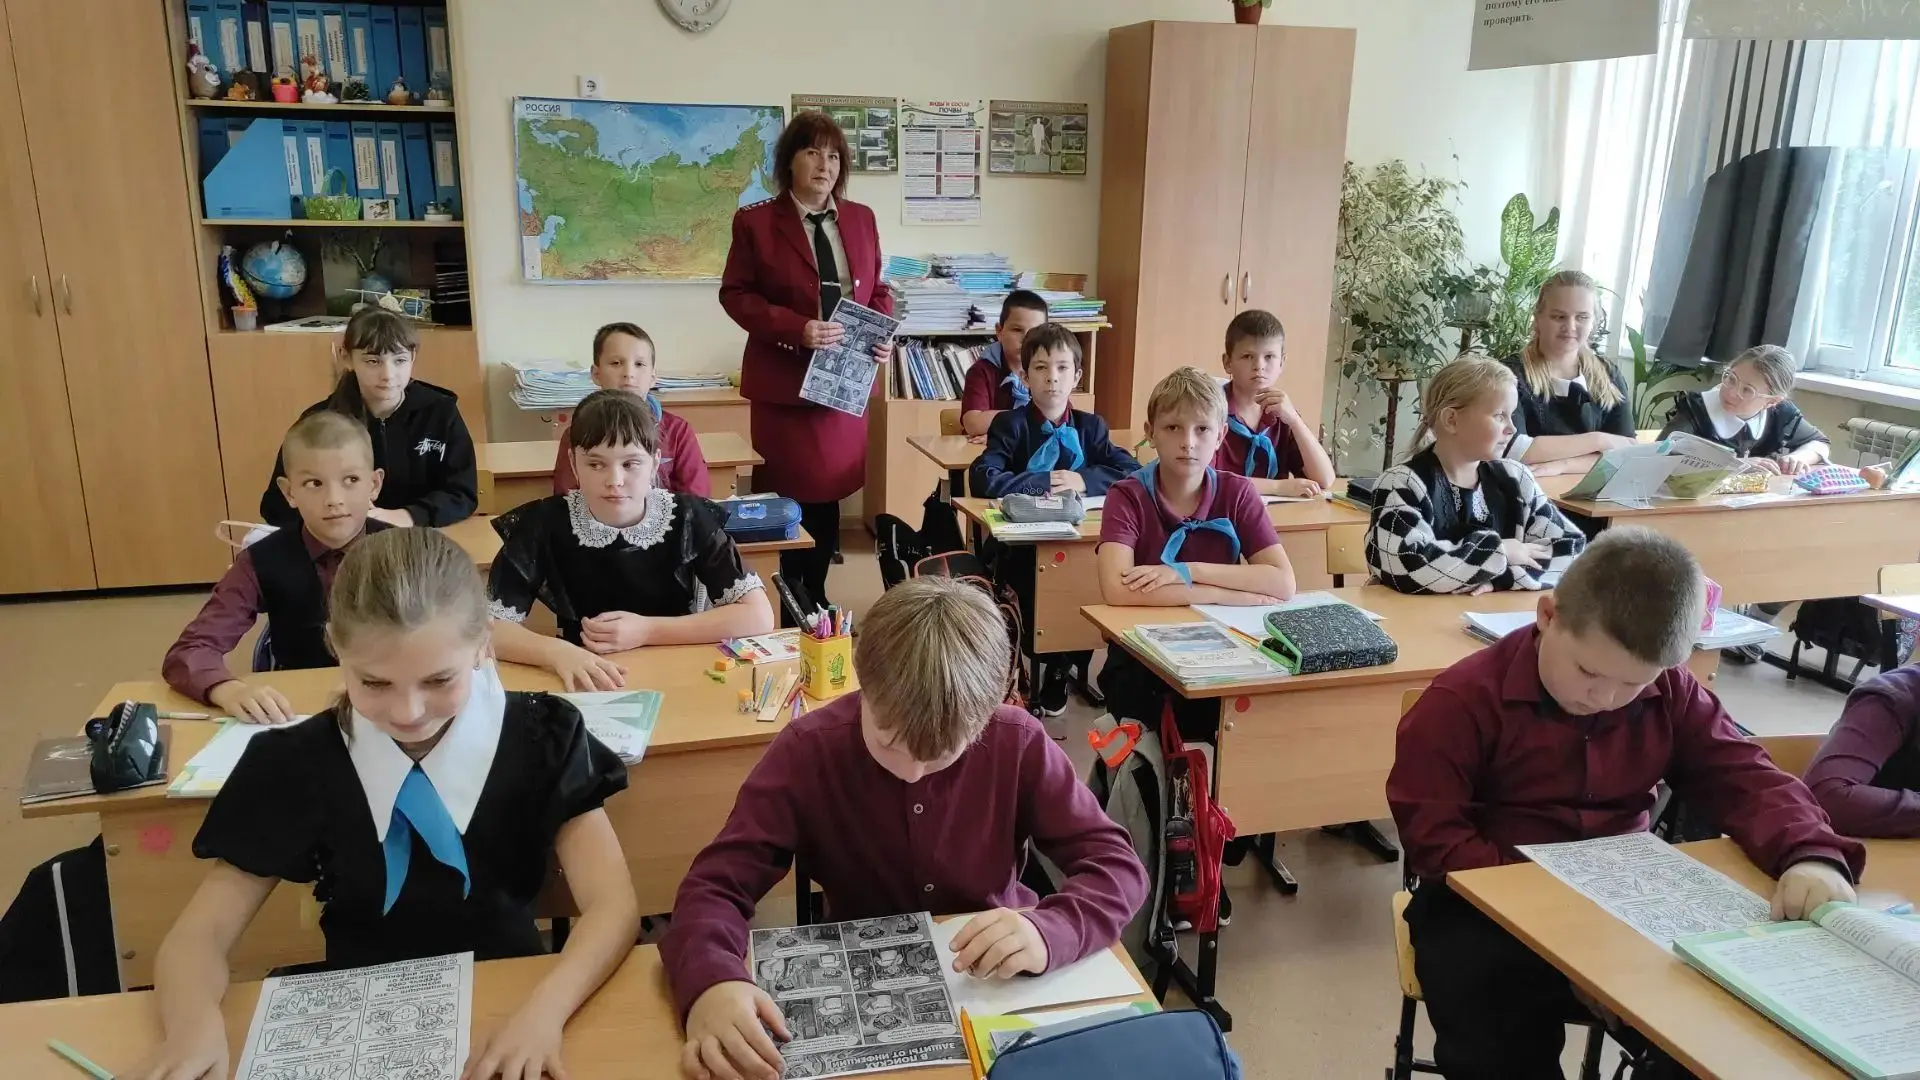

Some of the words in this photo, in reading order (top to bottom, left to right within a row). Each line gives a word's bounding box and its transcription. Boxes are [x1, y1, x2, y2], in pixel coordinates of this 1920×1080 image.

[1483, 14, 1534, 28] проверить.
[525, 103, 561, 113] РОССИЯ
[892, 1050, 906, 1058] ОТ
[908, 1042, 956, 1056] ЗАЩИТЫ
[831, 1052, 890, 1069] ИНФЕКЦИЙ
[865, 1054, 918, 1069] ПОИСКАХ
